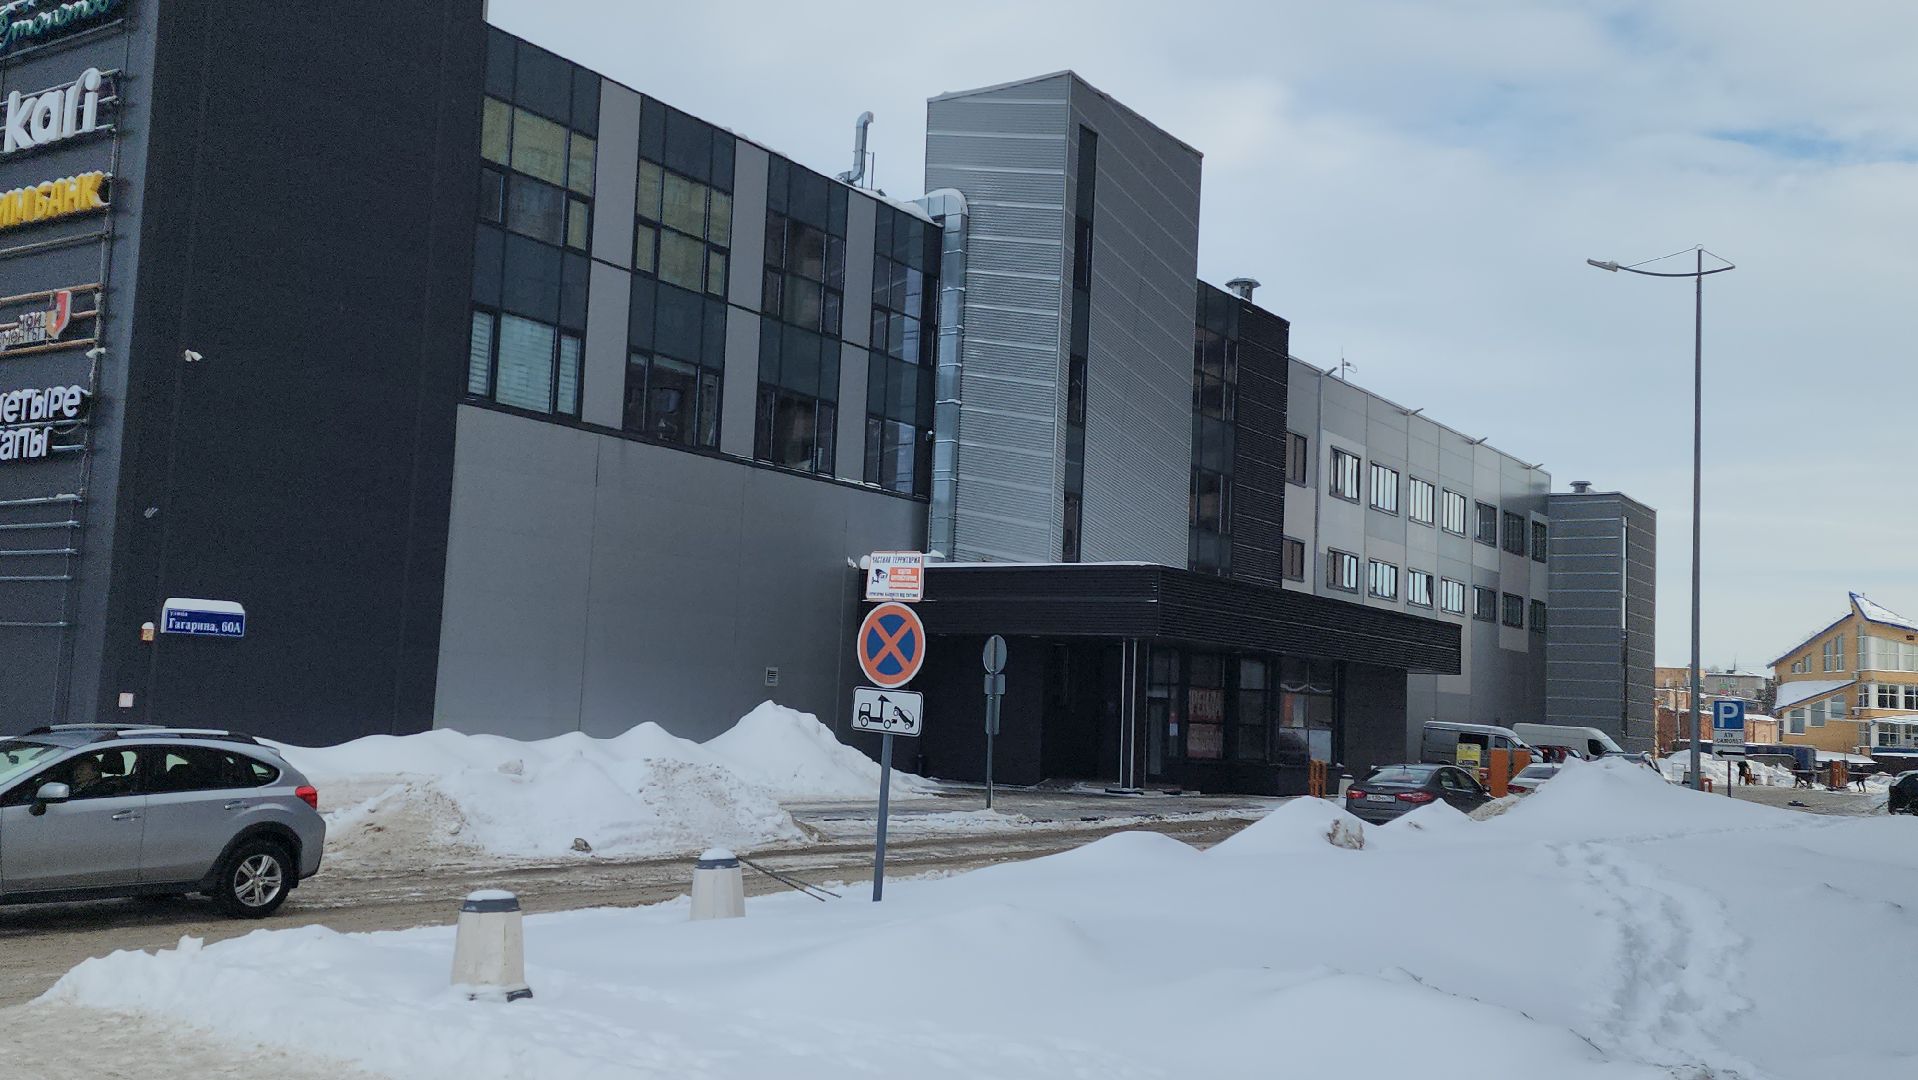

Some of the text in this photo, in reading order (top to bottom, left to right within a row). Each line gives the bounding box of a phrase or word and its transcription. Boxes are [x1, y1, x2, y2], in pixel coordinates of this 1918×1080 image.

[4, 68, 101, 153] kari
[168, 618, 241, 633] Гагарина, 60А
